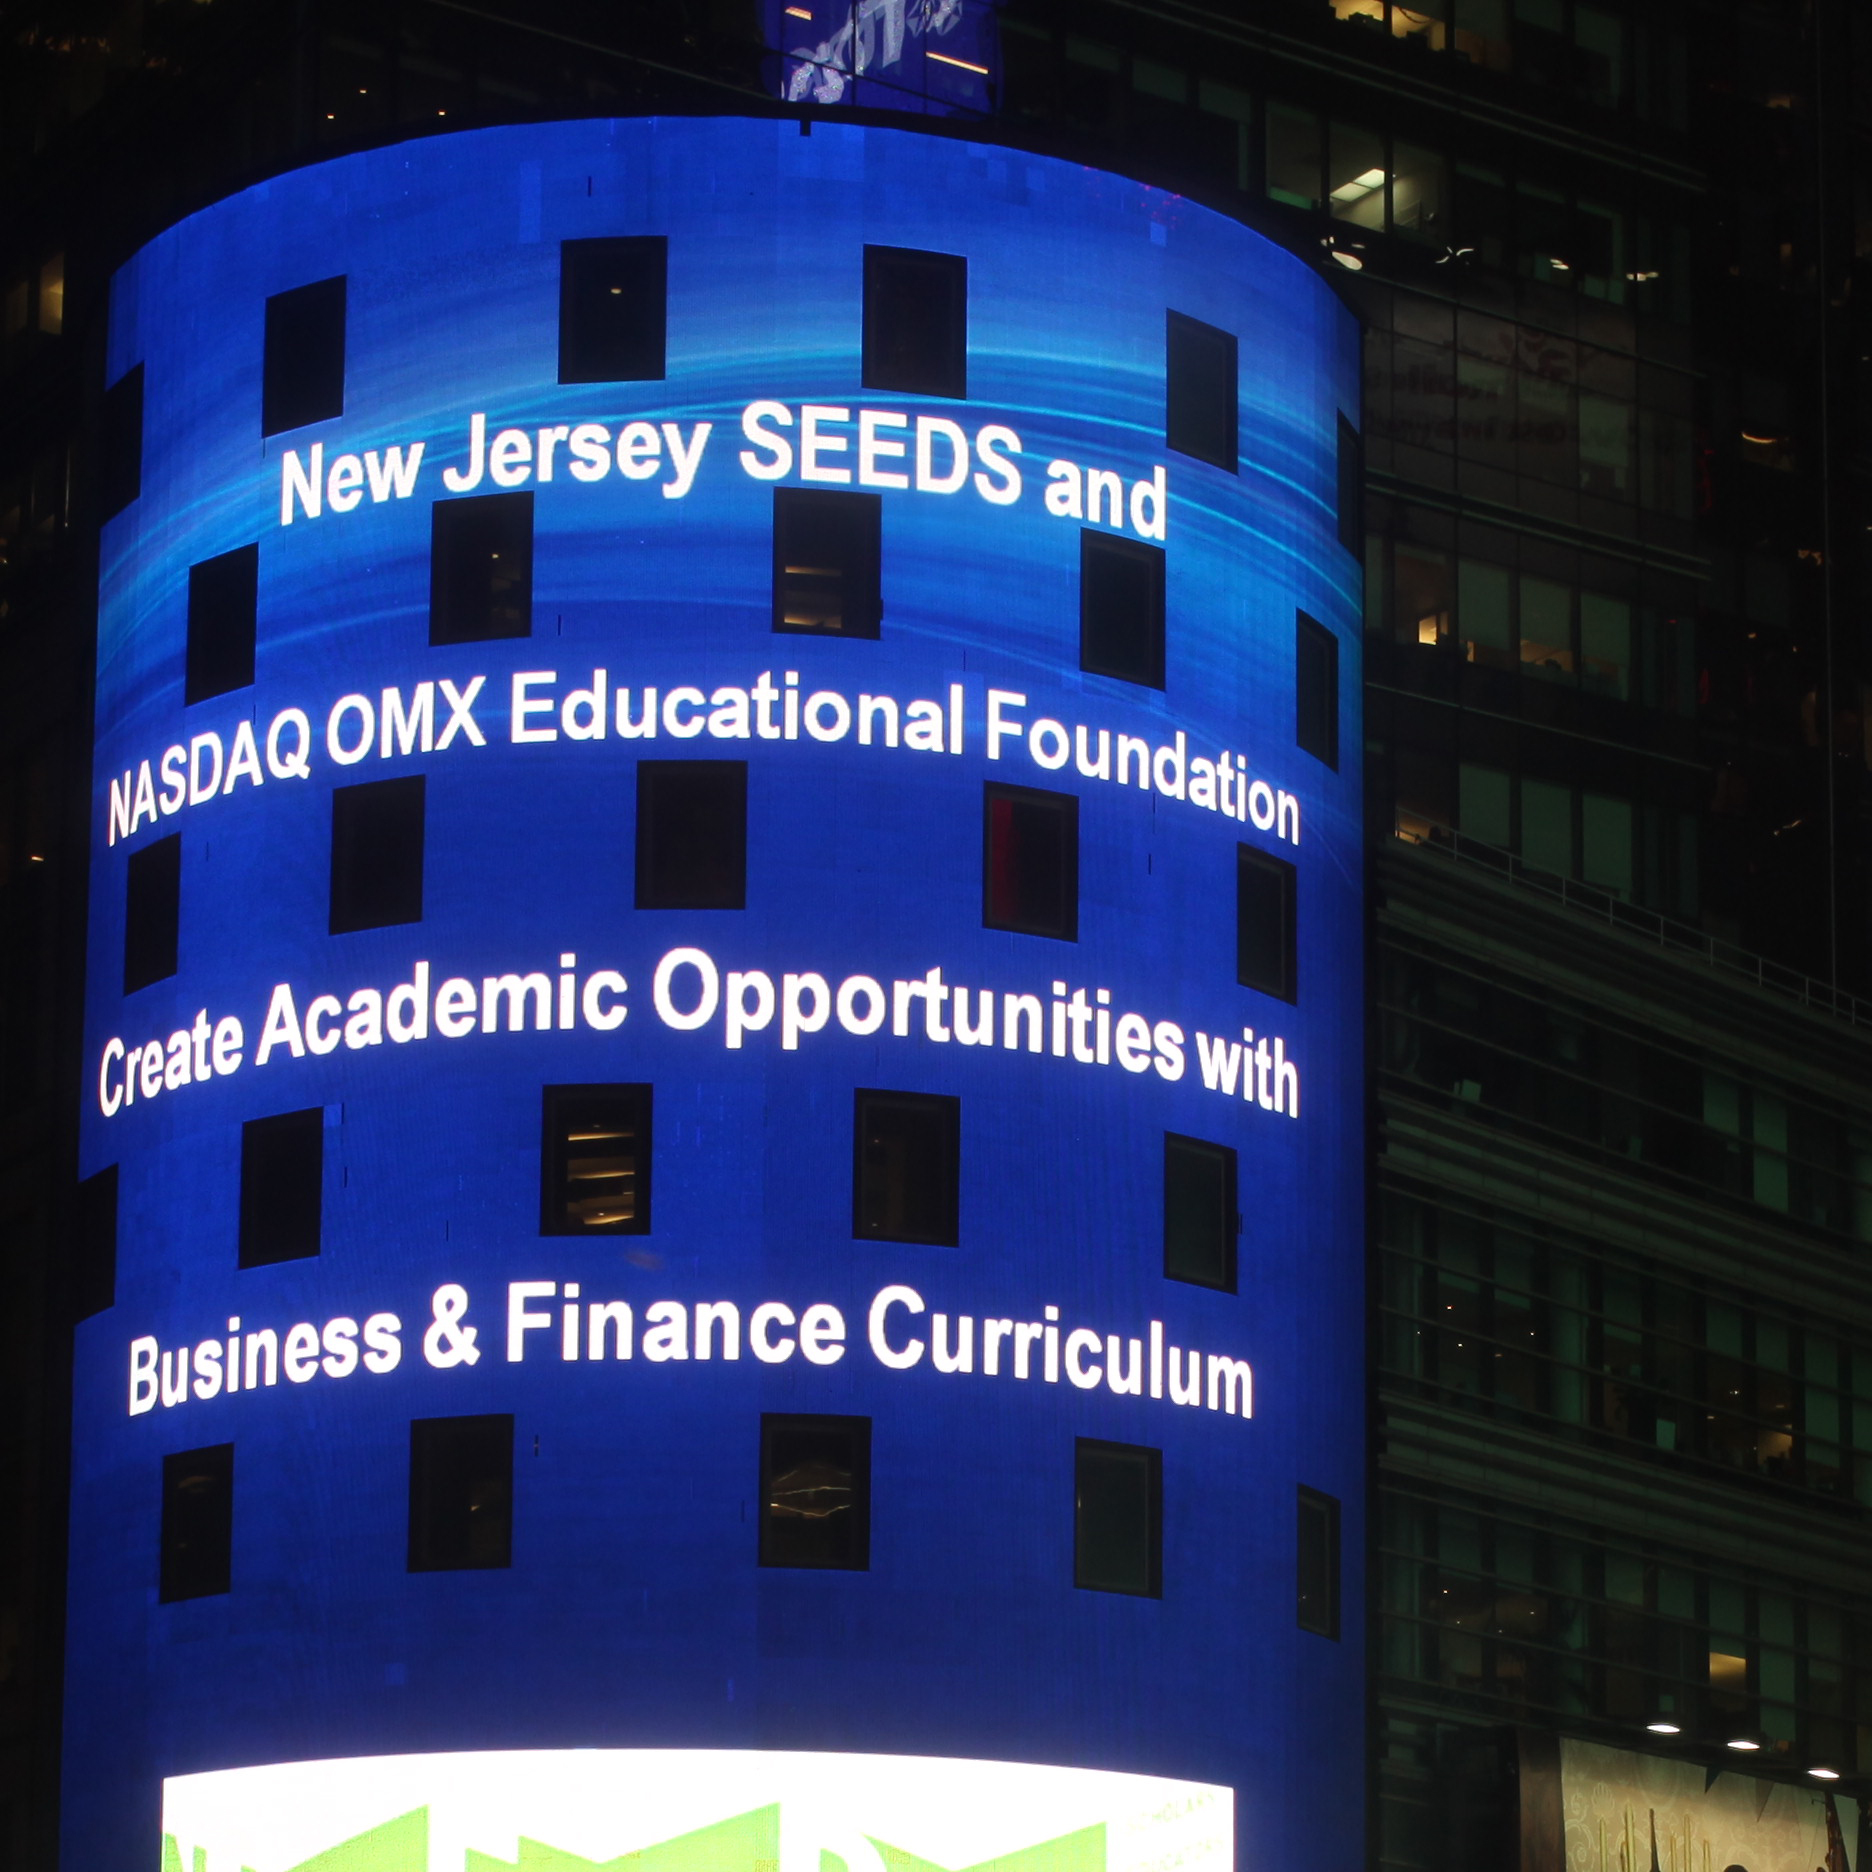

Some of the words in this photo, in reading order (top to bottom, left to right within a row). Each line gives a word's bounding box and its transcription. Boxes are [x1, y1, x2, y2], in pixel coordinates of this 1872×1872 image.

[279, 442, 425, 527] New
[443, 413, 712, 500] Jersey
[740, 402, 1023, 505] SEEDS
[1044, 458, 1167, 541] and
[107, 706, 312, 847] NASDAQ
[327, 676, 486, 769] OMX
[510, 670, 964, 755] Educational
[986, 689, 1301, 847] Foundation
[99, 1011, 242, 1118] Create
[256, 954, 628, 1065] Academic
[652, 947, 1186, 1083] Opportunities
[1198, 1025, 1301, 1118] with
[129, 1304, 400, 1418] Business
[423, 1283, 481, 1369] &
[508, 1280, 845, 1365] Finance
[867, 1285, 1253, 1419] Curriculum
